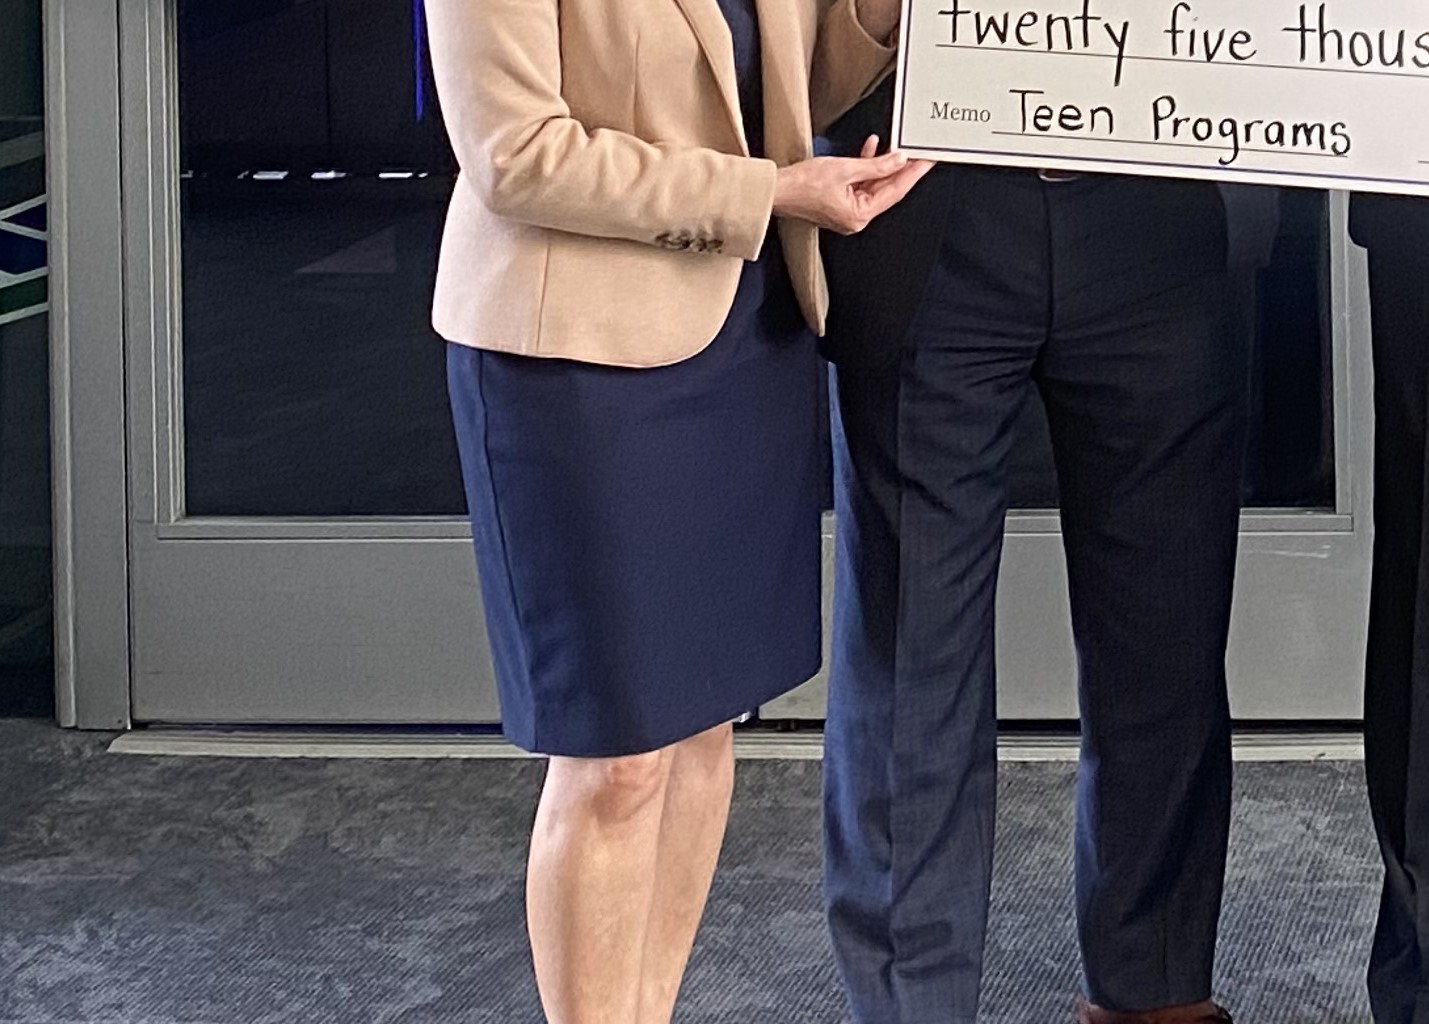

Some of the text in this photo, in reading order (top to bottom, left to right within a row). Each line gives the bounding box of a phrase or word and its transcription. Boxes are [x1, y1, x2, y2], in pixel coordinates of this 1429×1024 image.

[1163, 2, 1257, 62] five
[930, 102, 992, 123] Memo
[1009, 89, 1351, 166] Teen Programs
